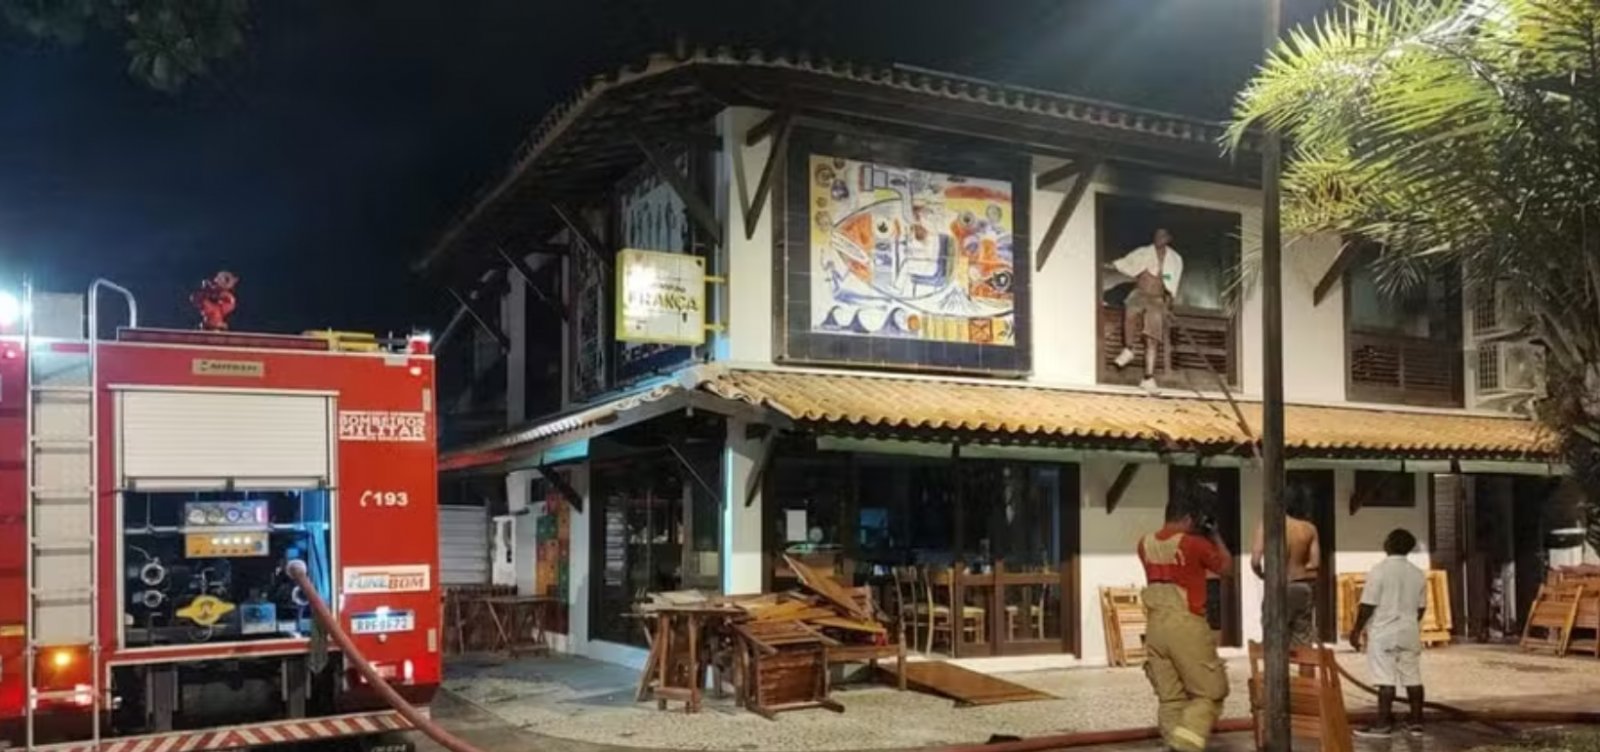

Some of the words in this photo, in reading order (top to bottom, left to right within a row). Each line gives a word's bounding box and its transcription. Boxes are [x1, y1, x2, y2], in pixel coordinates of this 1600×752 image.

[340, 414, 425, 427] BOMBEIROS
[340, 425, 425, 438] MILITAR
[372, 491, 409, 507] 193
